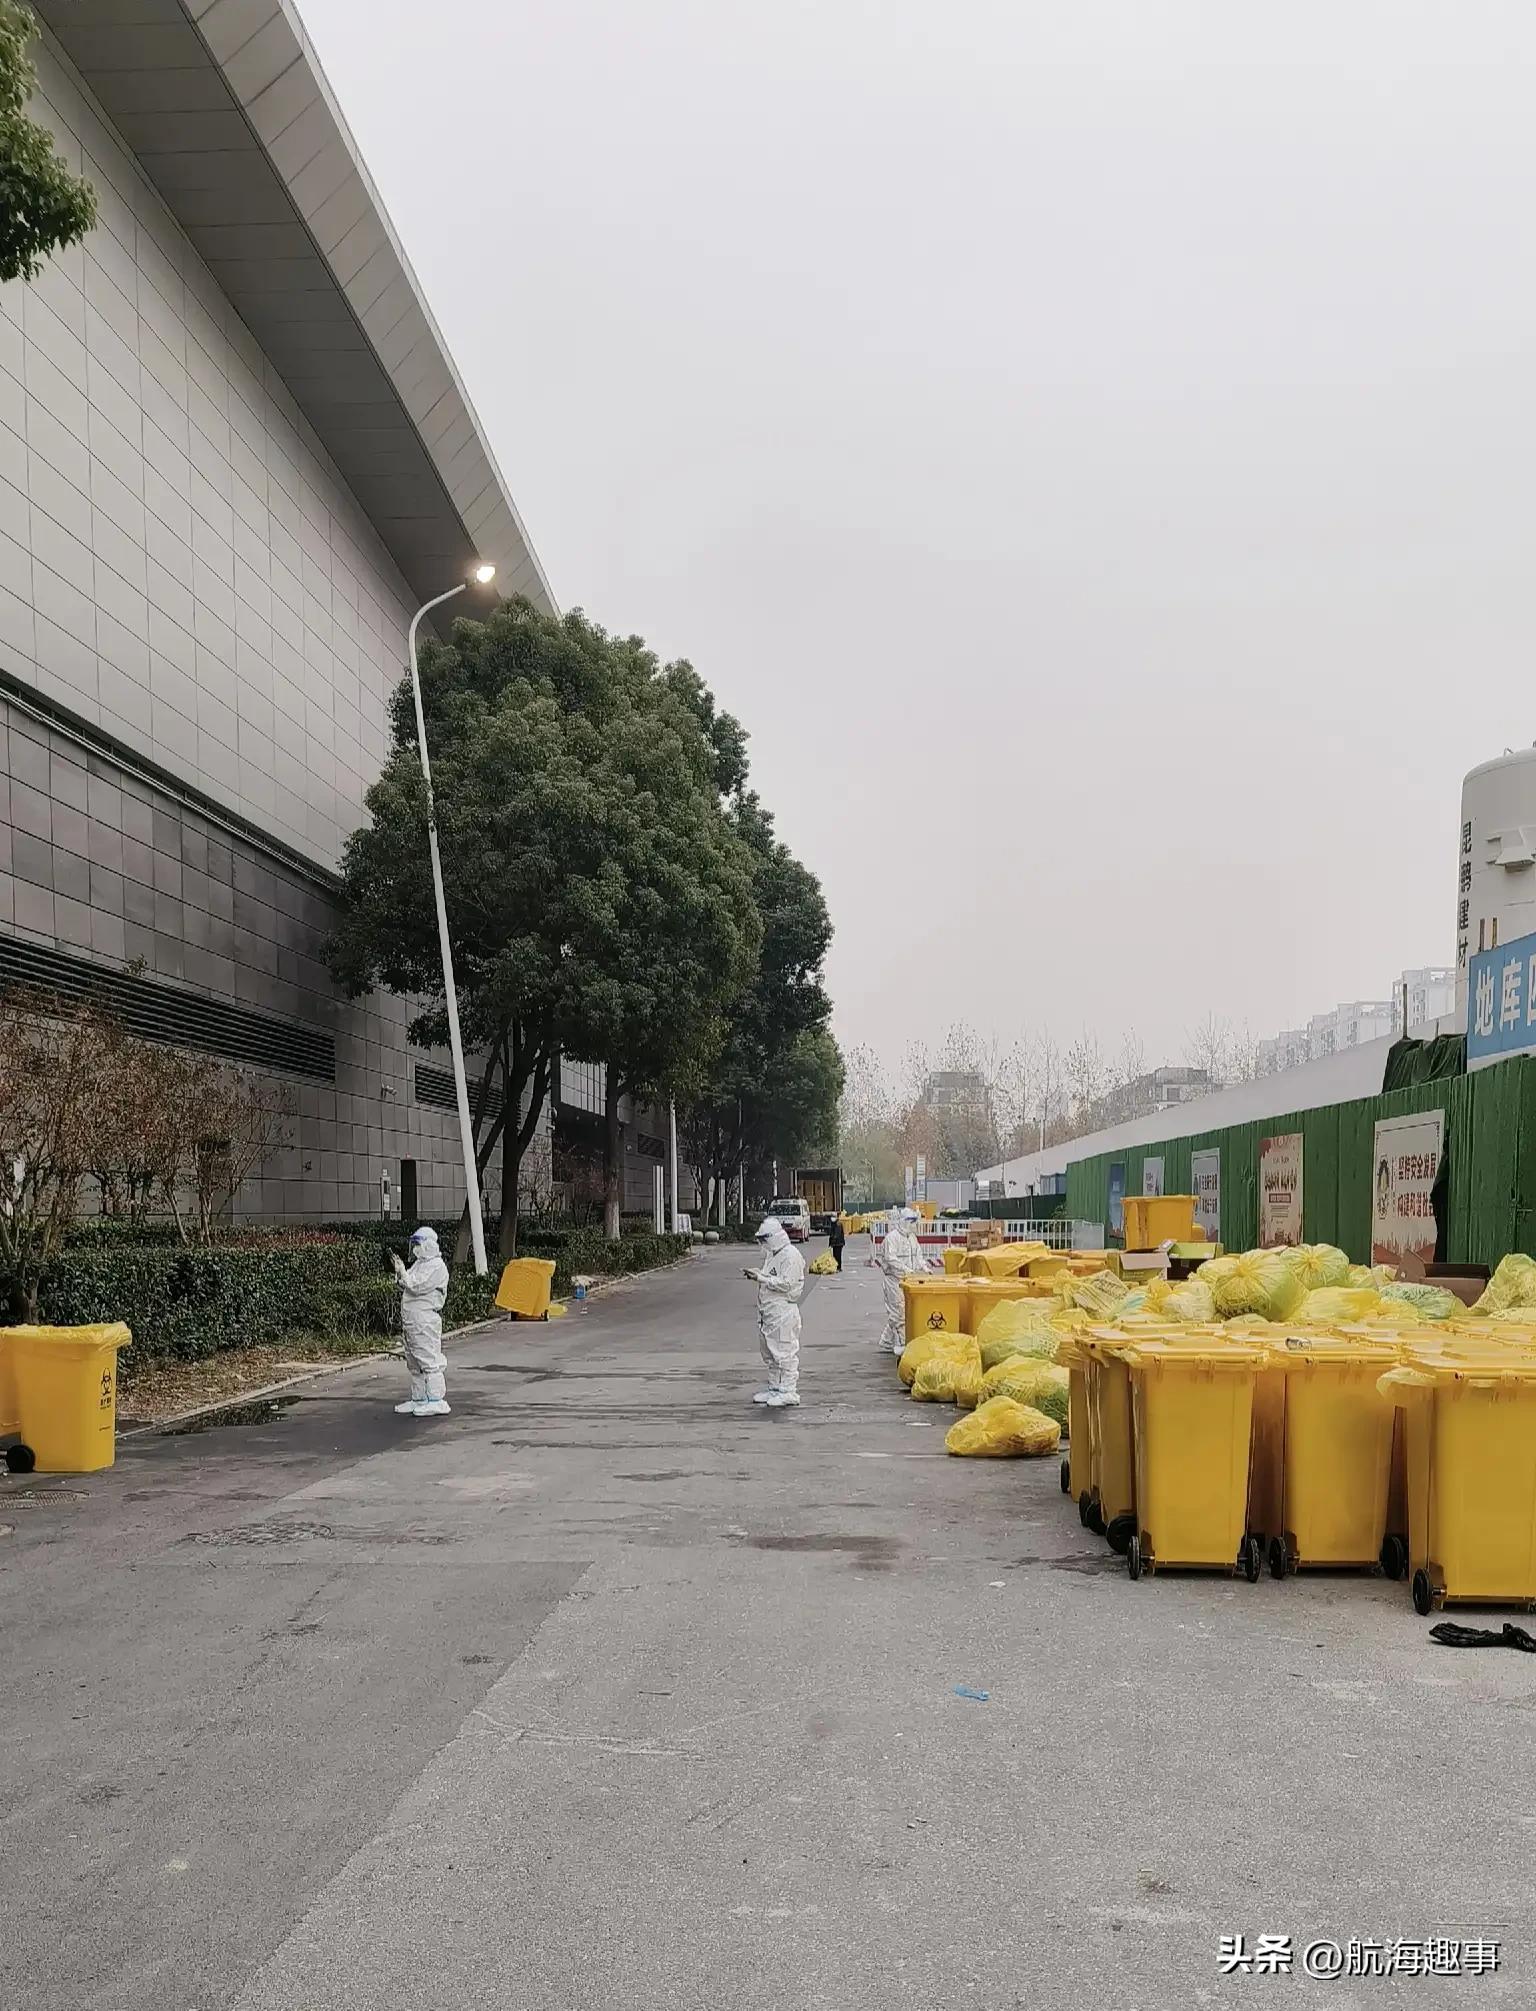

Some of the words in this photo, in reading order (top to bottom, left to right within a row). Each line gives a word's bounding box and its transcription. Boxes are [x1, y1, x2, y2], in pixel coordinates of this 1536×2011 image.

[1398, 1152, 1437, 1181] 坚持安全发展
